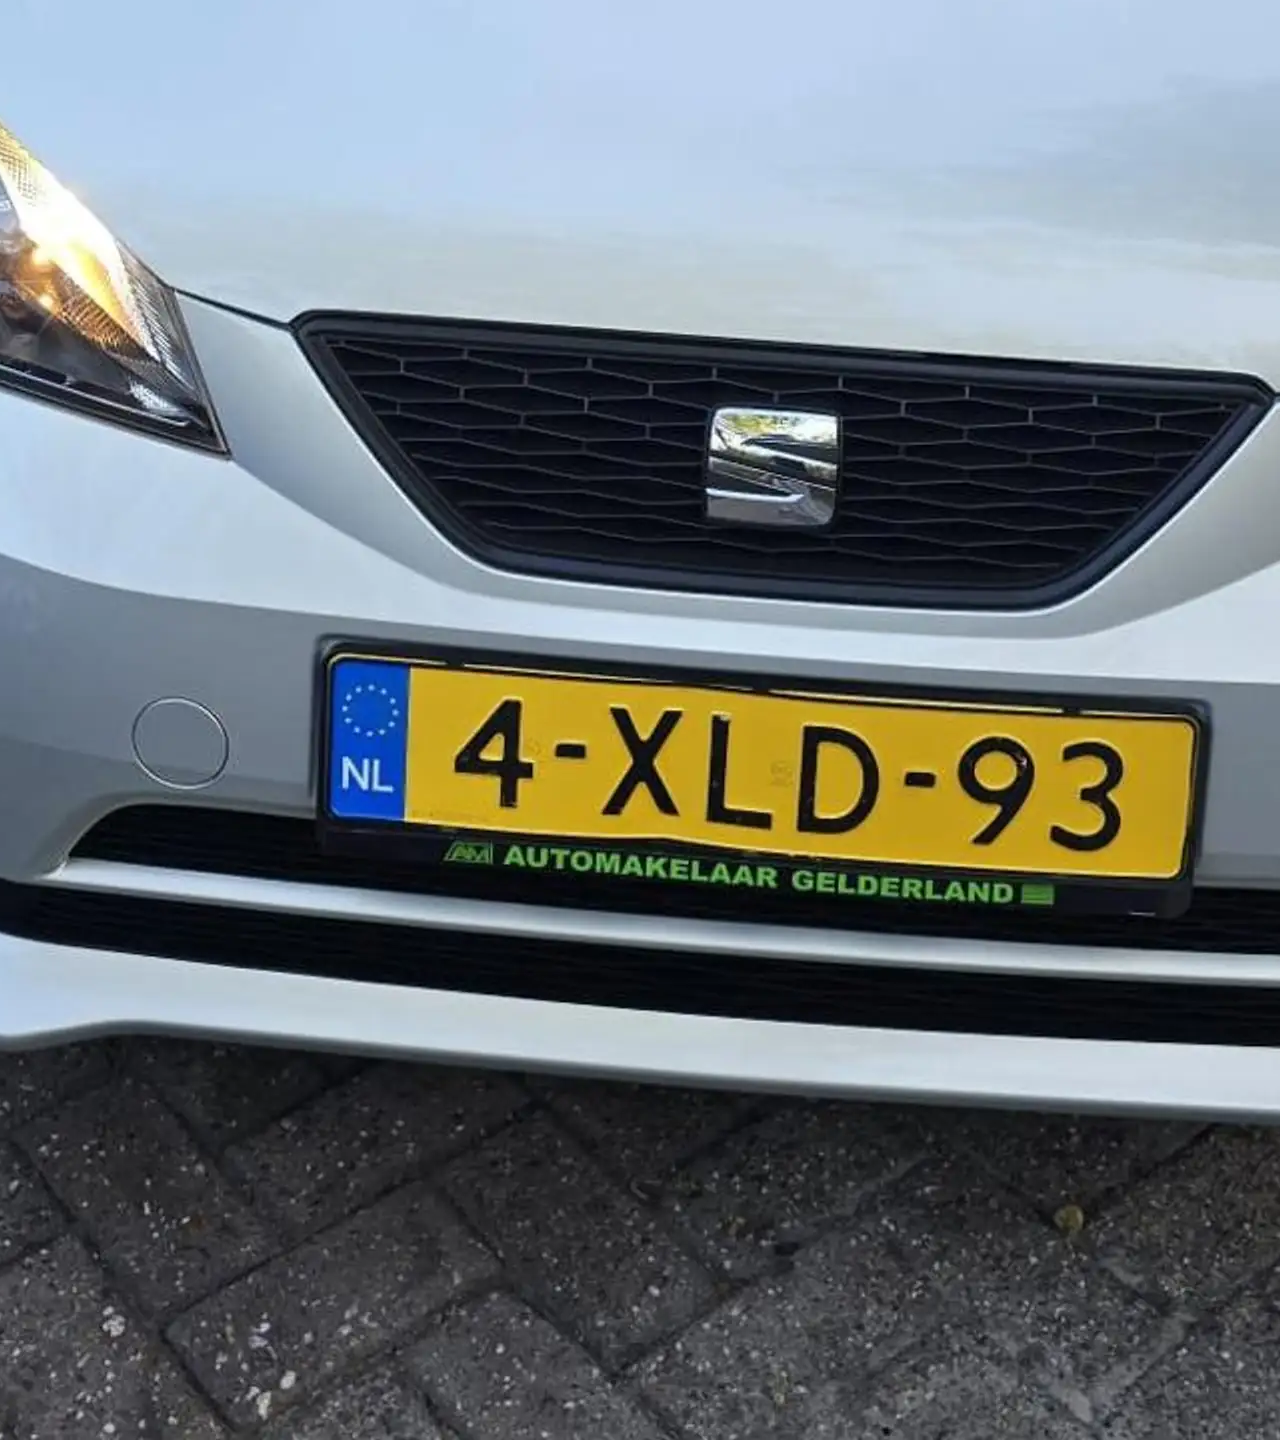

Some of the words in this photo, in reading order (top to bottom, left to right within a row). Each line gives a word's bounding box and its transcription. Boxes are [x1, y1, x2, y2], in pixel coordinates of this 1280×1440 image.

[342, 756, 394, 793] NL
[454, 698, 1124, 852] 4-XLD-93
[503, 843, 778, 888] AUTOMAKELAAR
[792, 869, 1013, 904] GELDERLAND
